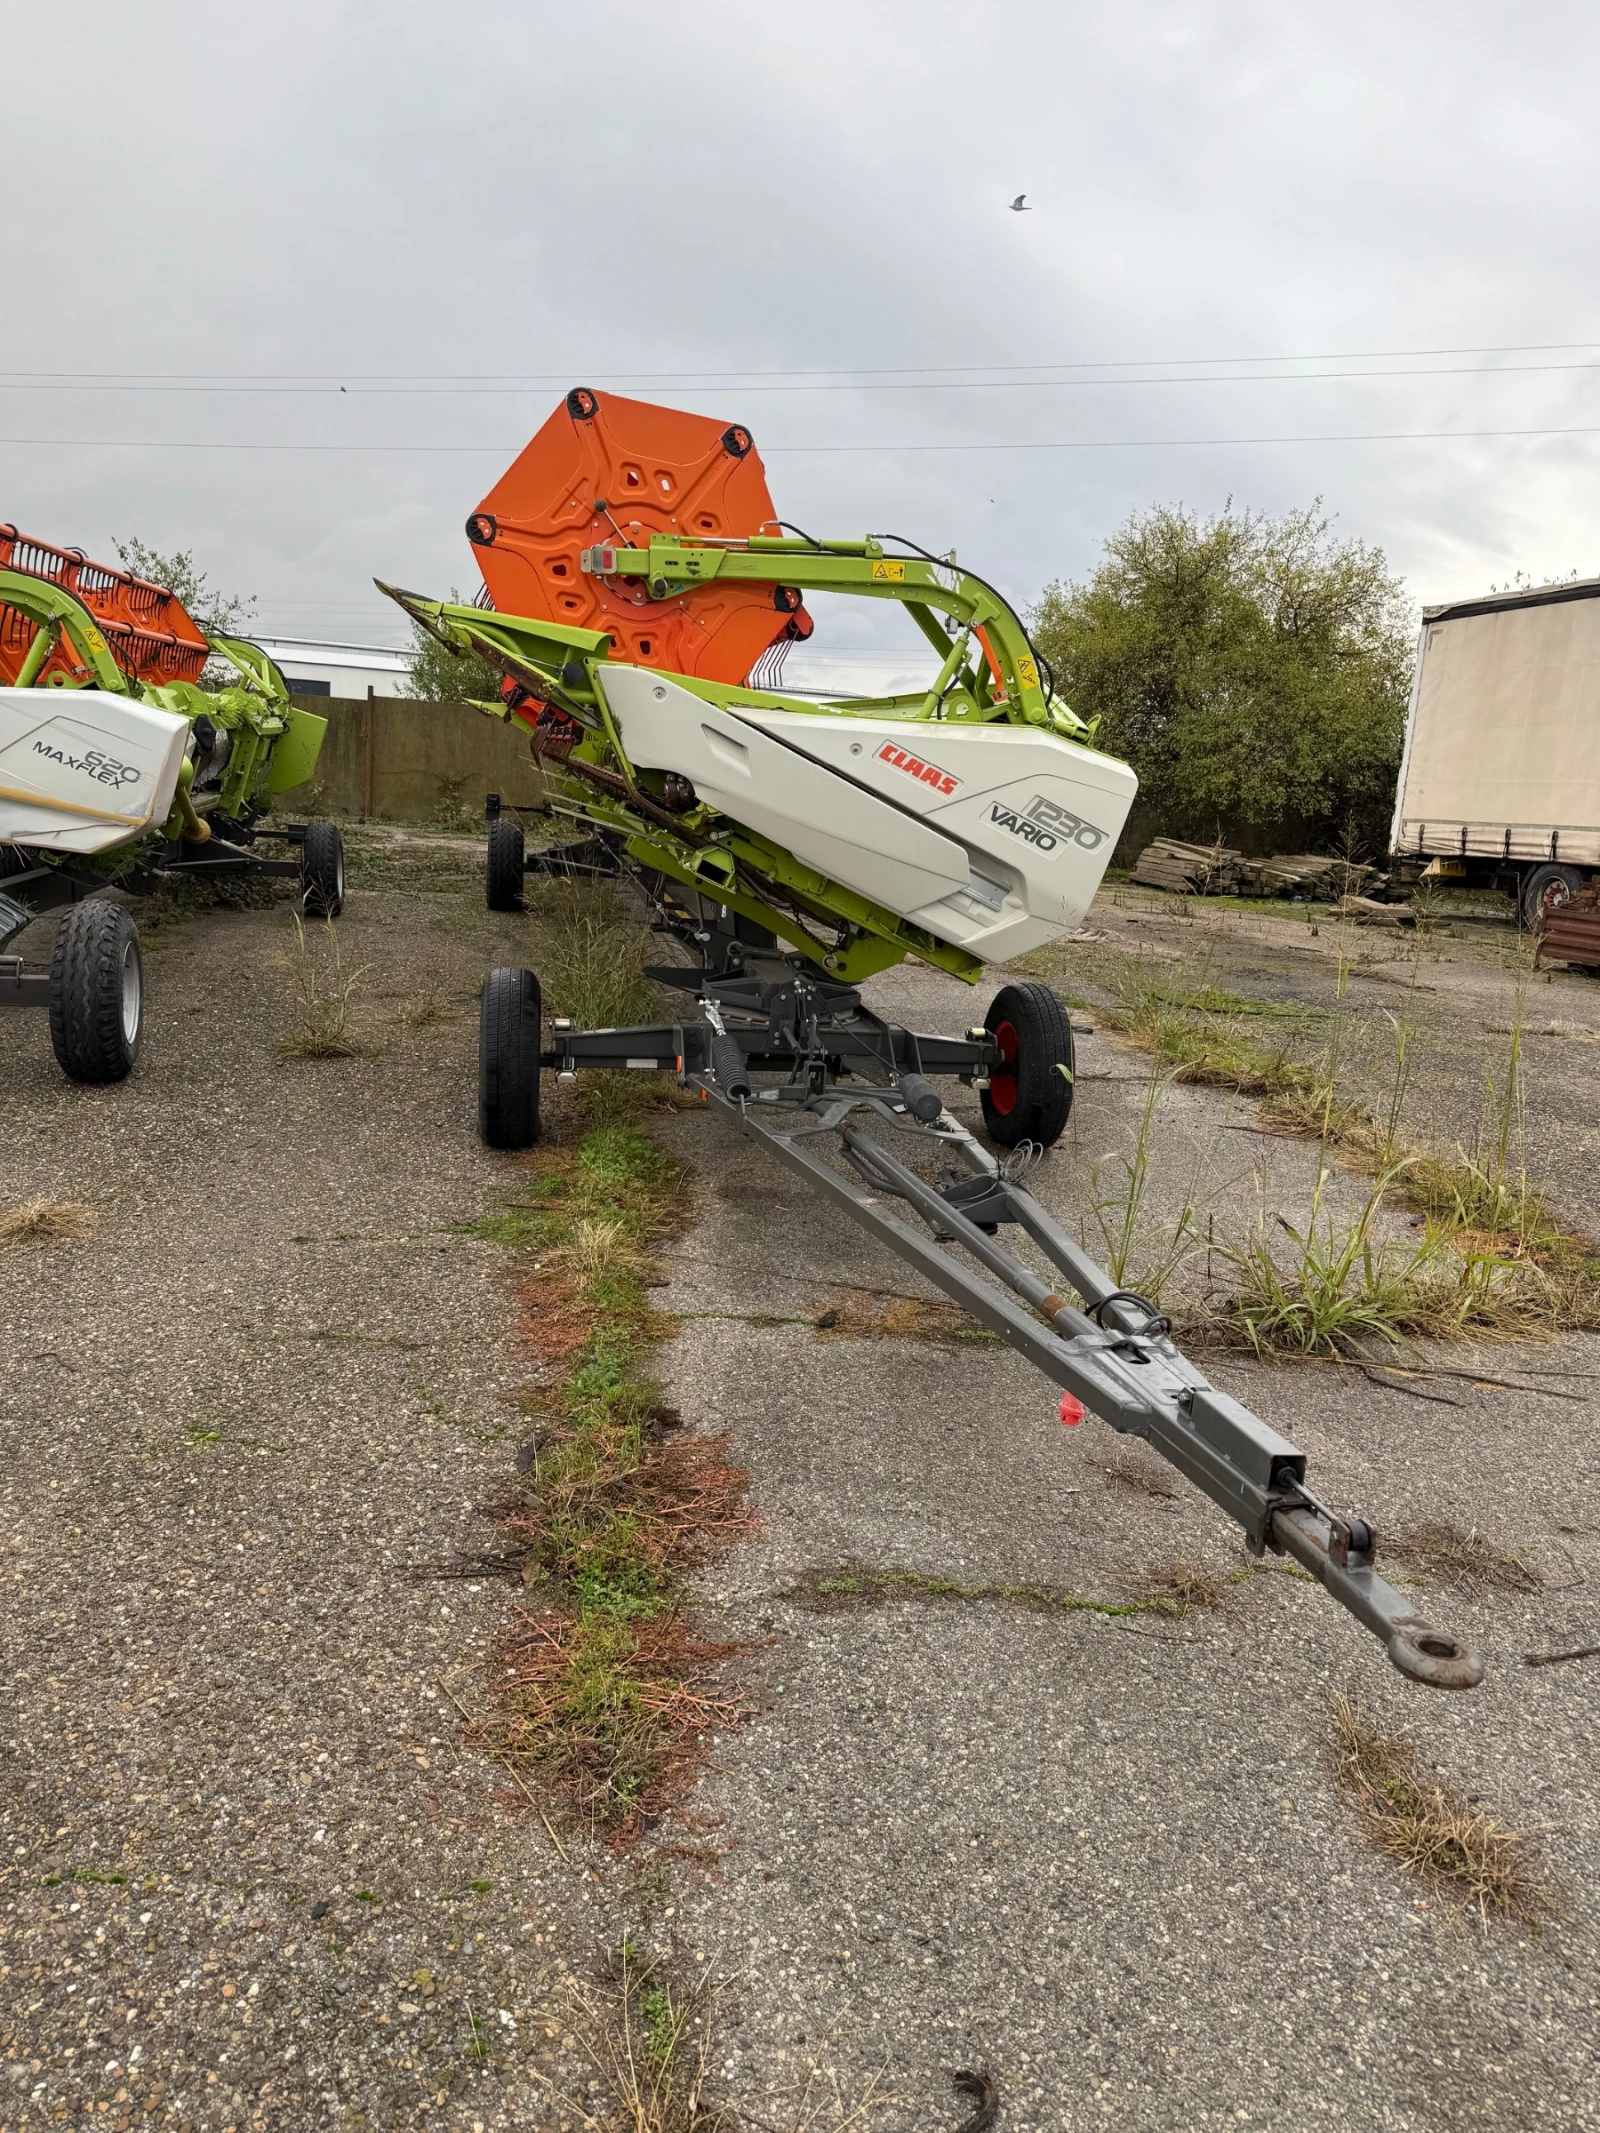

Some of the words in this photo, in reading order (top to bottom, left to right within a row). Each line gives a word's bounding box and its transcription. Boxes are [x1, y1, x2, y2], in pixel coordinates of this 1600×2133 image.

[32, 741, 125, 790] MAXFLEX
[85, 751, 141, 783] 620
[879, 744, 959, 795] CLAAS
[990, 804, 1056, 851] VARIO
[1026, 799, 1103, 850] 1230
